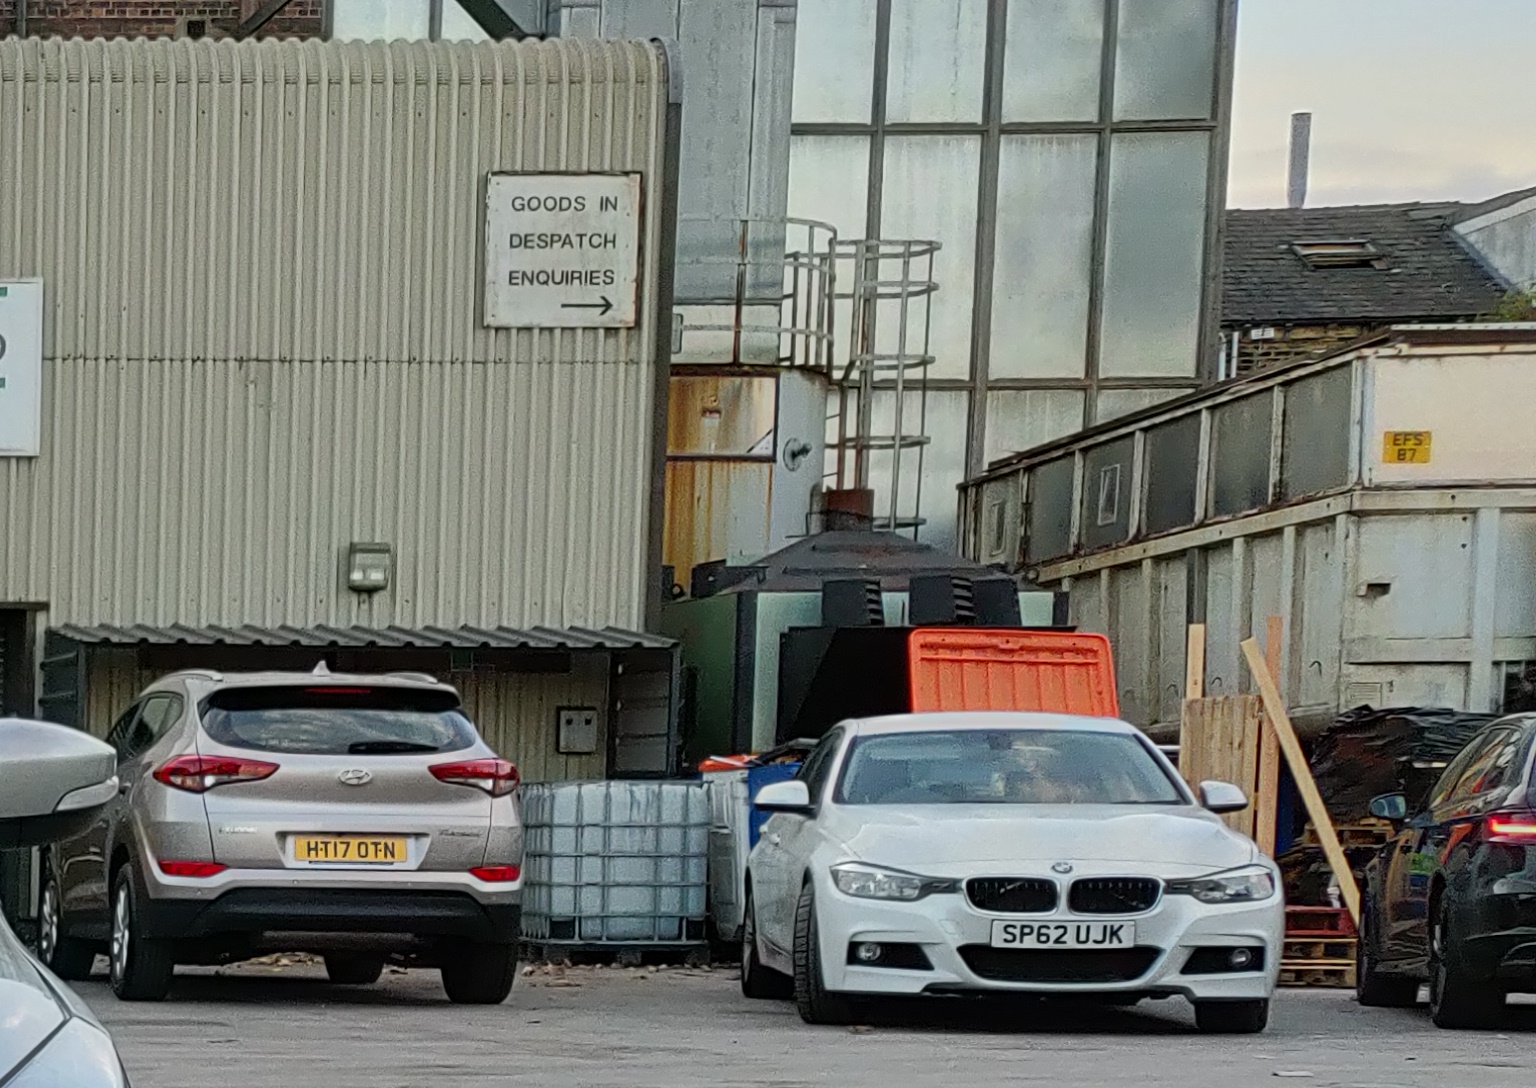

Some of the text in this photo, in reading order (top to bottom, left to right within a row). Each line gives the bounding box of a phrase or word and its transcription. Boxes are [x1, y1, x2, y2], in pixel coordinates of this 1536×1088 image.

[511, 195, 619, 212] GOODS IN
[509, 233, 617, 250] DESPATCH
[508, 269, 616, 287] ENQUIRIES
[1392, 432, 1424, 447] EFS
[306, 840, 396, 860] HT17 OTN
[1003, 924, 1125, 945] SP62 UJK
